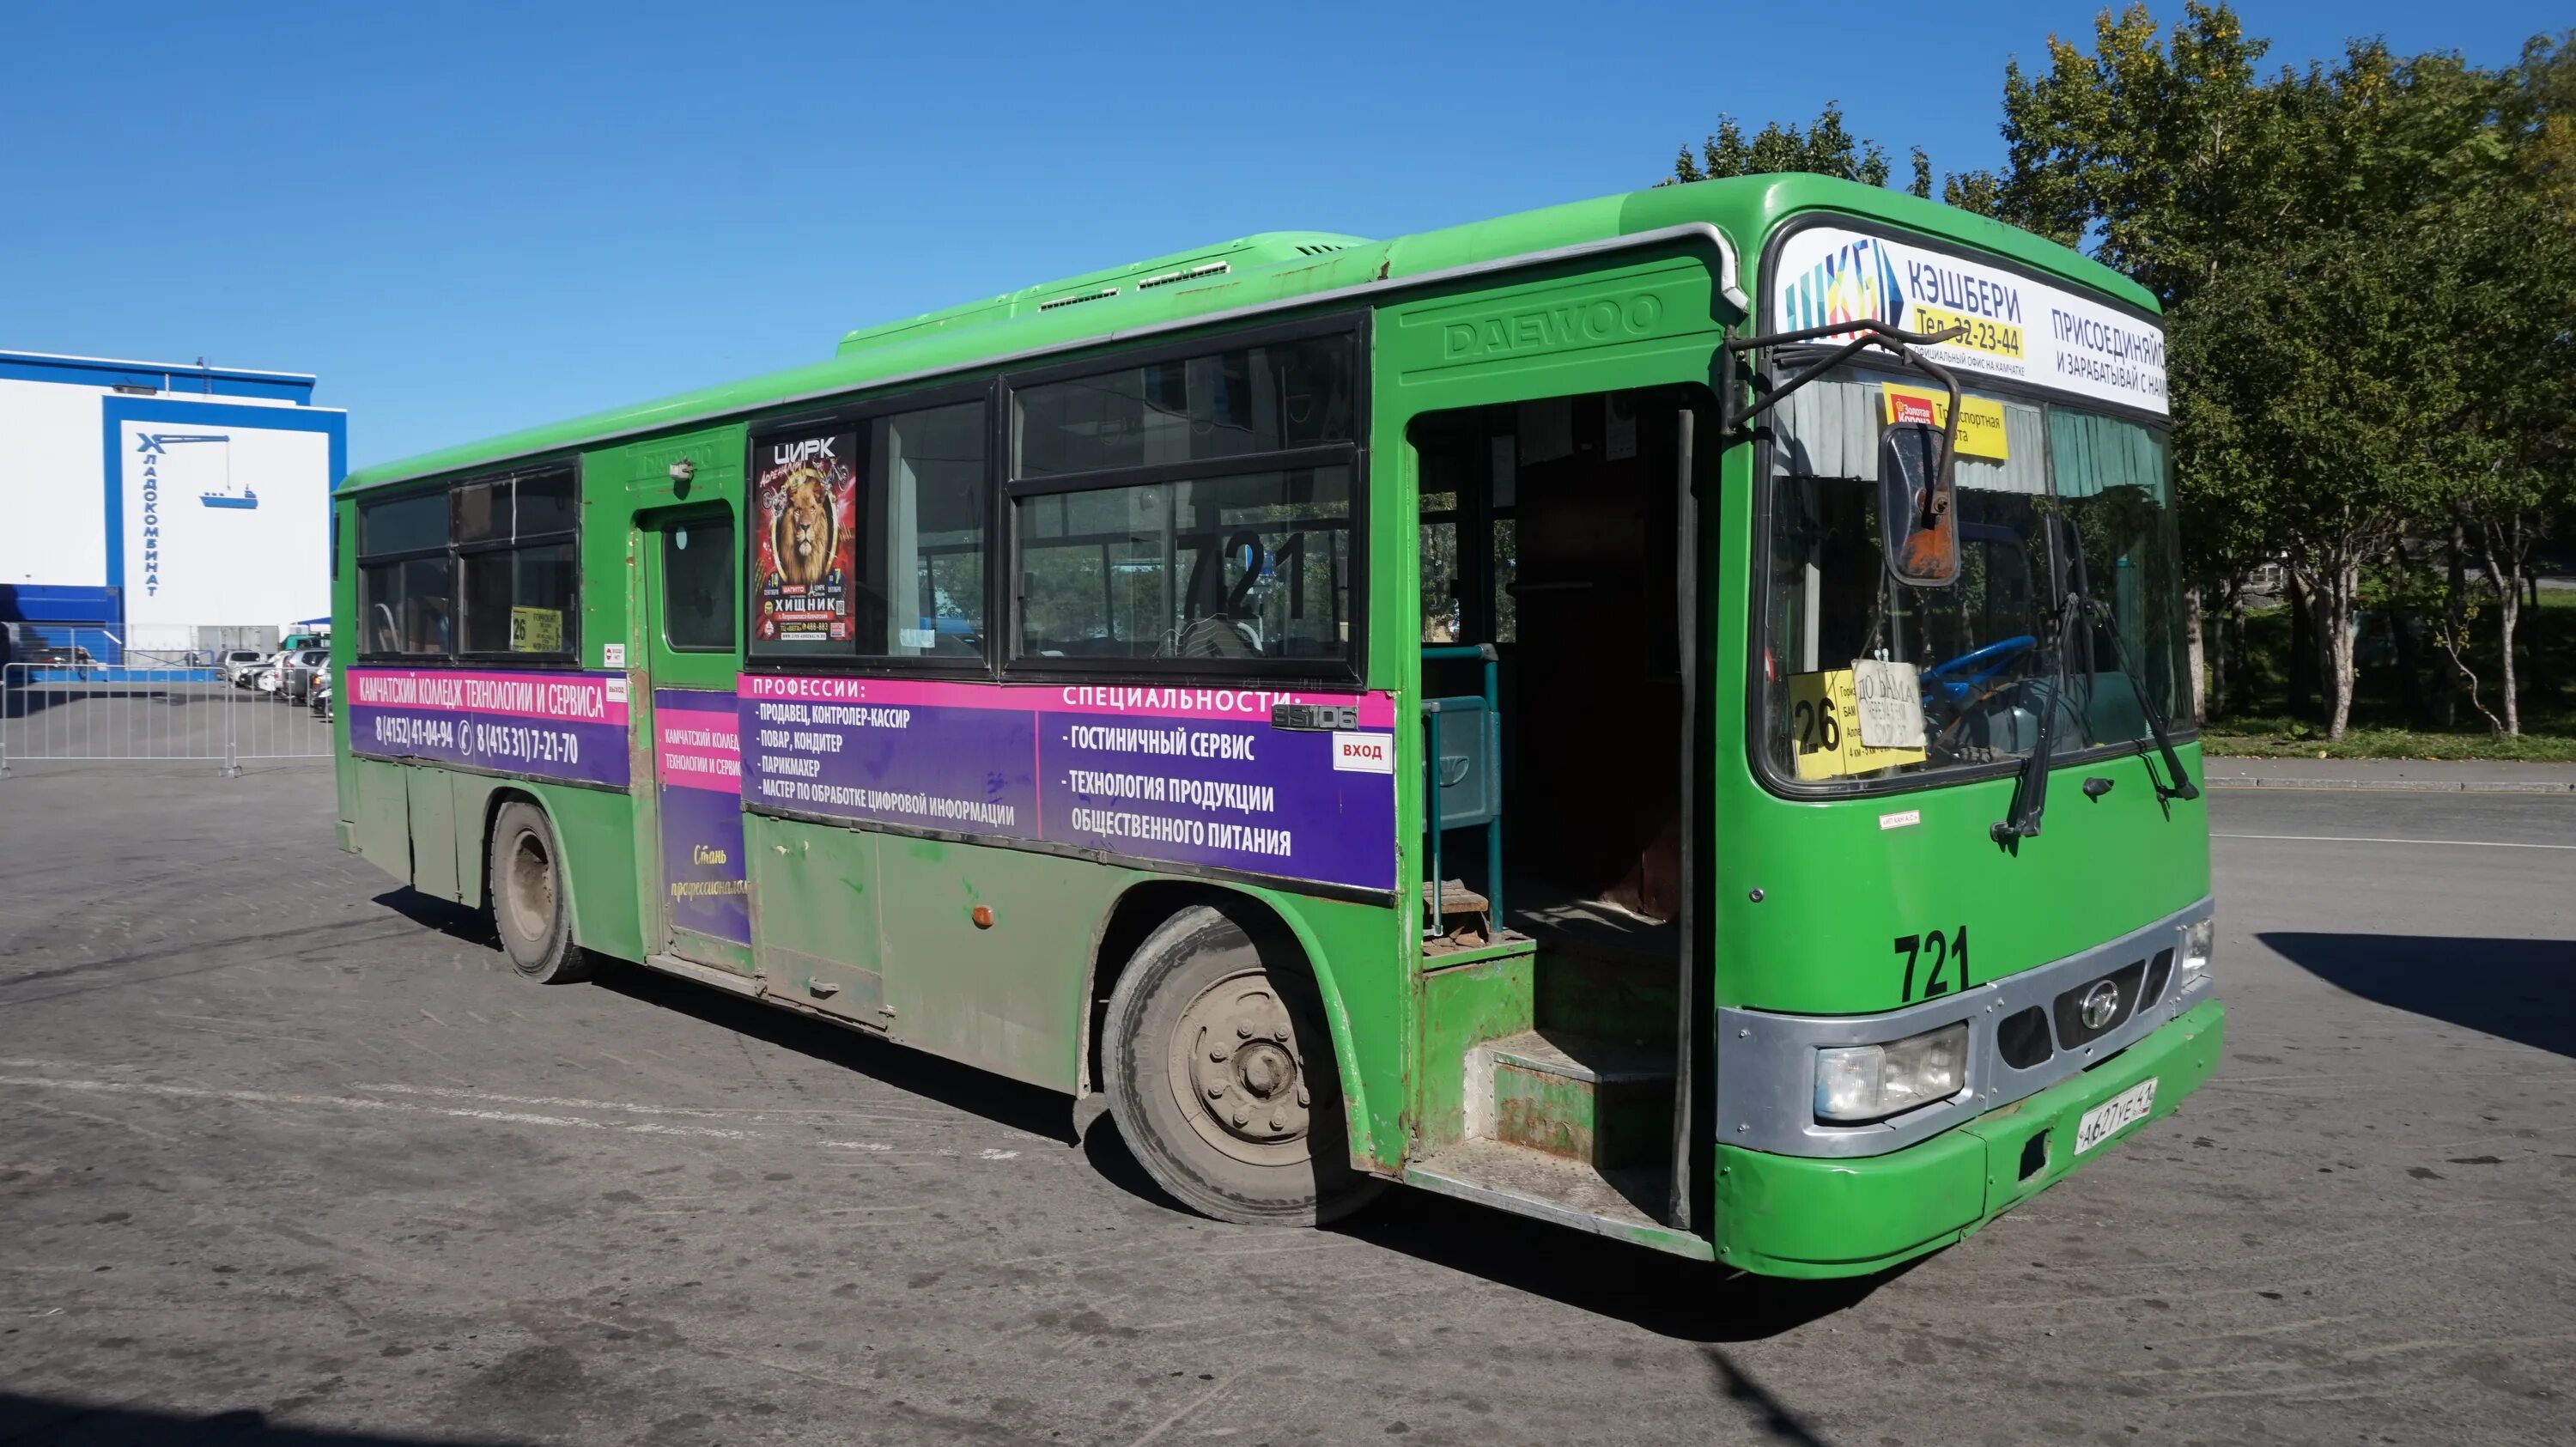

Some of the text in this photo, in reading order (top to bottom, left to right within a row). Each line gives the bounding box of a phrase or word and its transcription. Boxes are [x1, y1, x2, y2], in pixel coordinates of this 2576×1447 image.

[1908, 259, 2021, 324] КЭШБЕРИ
[1443, 293, 1663, 360] DAEWOO
[1914, 346, 2025, 376] ОФИЦИАЛЬНЫЙ ОФИС НА КАМЧАТКЕ
[2057, 350, 2065, 374] И
[2068, 353, 2139, 391] ЗАРАБАТЫВАЙ
[2141, 374, 2147, 393] С
[1903, 404, 1930, 417] Золотая
[1935, 403, 2001, 429] Трспортная
[775, 436, 836, 465] ЦИРК
[137, 432, 166, 597] ХЛАДОКОМБИНАТ
[775, 598, 835, 612] ХИЩНИК
[513, 618, 526, 641] 26
[359, 672, 605, 718] КАМЧАТСКИЙ КОЛЛЕДЖ ТЕХНОЛОГИИ И СЕРВИСА
[753, 678, 866, 698] ПРОФЕССИИ:
[812, 705, 910, 729] КОНТРОЛЕР-КАССИР
[1795, 696, 1839, 756] 26
[665, 728, 711, 747] КАМЧАТСКИЙ
[794, 732, 843, 754] КОНДИТЕР
[1071, 726, 1188, 756] ГОСТИНИЧНЫЙ
[1190, 732, 1255, 761] СЕРВИС
[665, 753, 708, 773] ТЕХНОЛОГИИ
[708, 757, 715, 774] И
[762, 755, 820, 777] ПАРИКМАХЕР
[1343, 745, 1382, 761] ВХОД
[762, 778, 795, 799] МАСТЕР
[797, 781, 810, 800] ПО
[811, 783, 866, 807] ОБРАБОТКЕ
[868, 789, 927, 815] ЦИФРОВОЙ
[929, 797, 1015, 828] ИНФОРМАЦИИ
[1068, 769, 1165, 801] ТЕХНОЛОГИЯ
[1169, 778, 1274, 814] ПРОДУКЦИИ
[1071, 807, 1291, 857] ОБЩЕСТВЕННОГО ПИТАНИЯ
[694, 844, 726, 865] Стань
[1894, 925, 1970, 1003] 721
